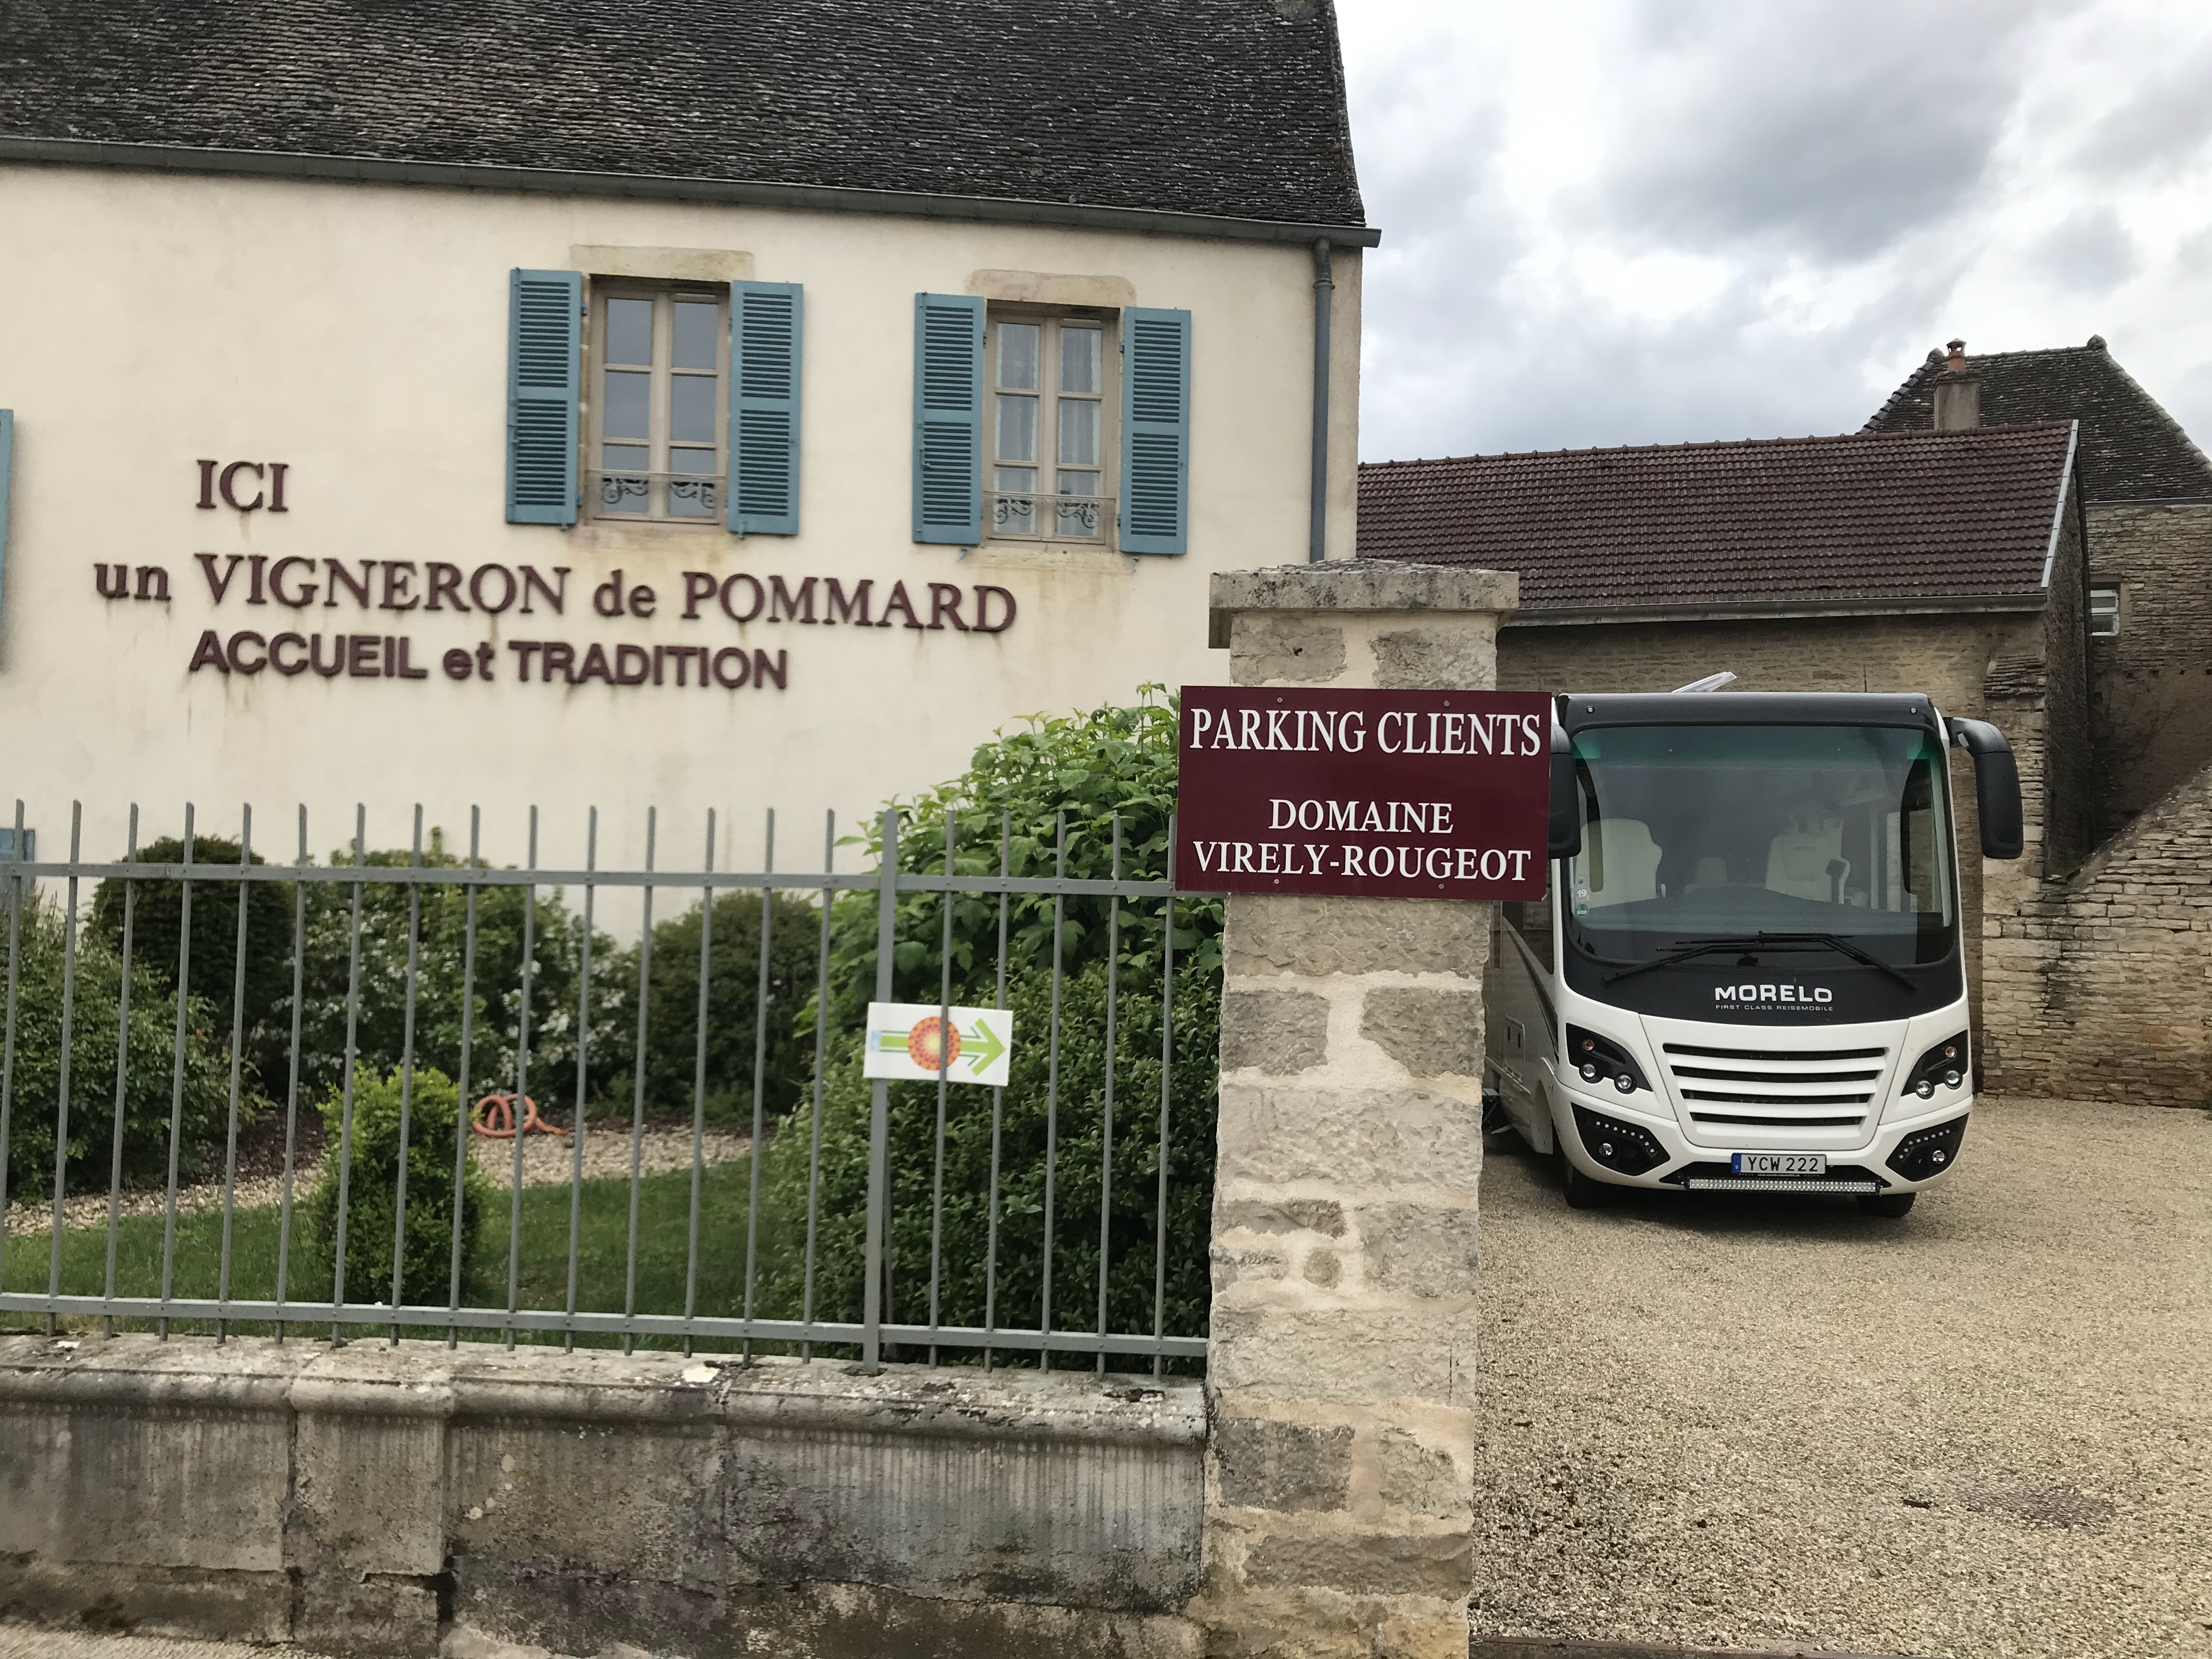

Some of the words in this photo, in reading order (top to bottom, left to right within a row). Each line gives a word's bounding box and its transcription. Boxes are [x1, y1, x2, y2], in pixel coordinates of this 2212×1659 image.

[195, 459, 290, 513] ICI
[93, 562, 172, 603] un
[194, 553, 571, 614] VIGNERON
[593, 568, 657, 619] de
[680, 571, 1018, 634] POMMARD
[188, 629, 429, 680] ACCUEIL
[442, 641, 496, 682] et
[507, 639, 788, 690] TRADITION
[1189, 708, 1367, 753] PARKING
[1378, 712, 1541, 756] CLIENTS
[1268, 799, 1454, 833] DOMAINE
[1193, 841, 1531, 881] VIRELY-ROUGEOT
[1715, 984, 1832, 1002] MORELO
[1747, 1156, 1781, 1171] YCW
[1786, 1157, 1818, 1172] 222
